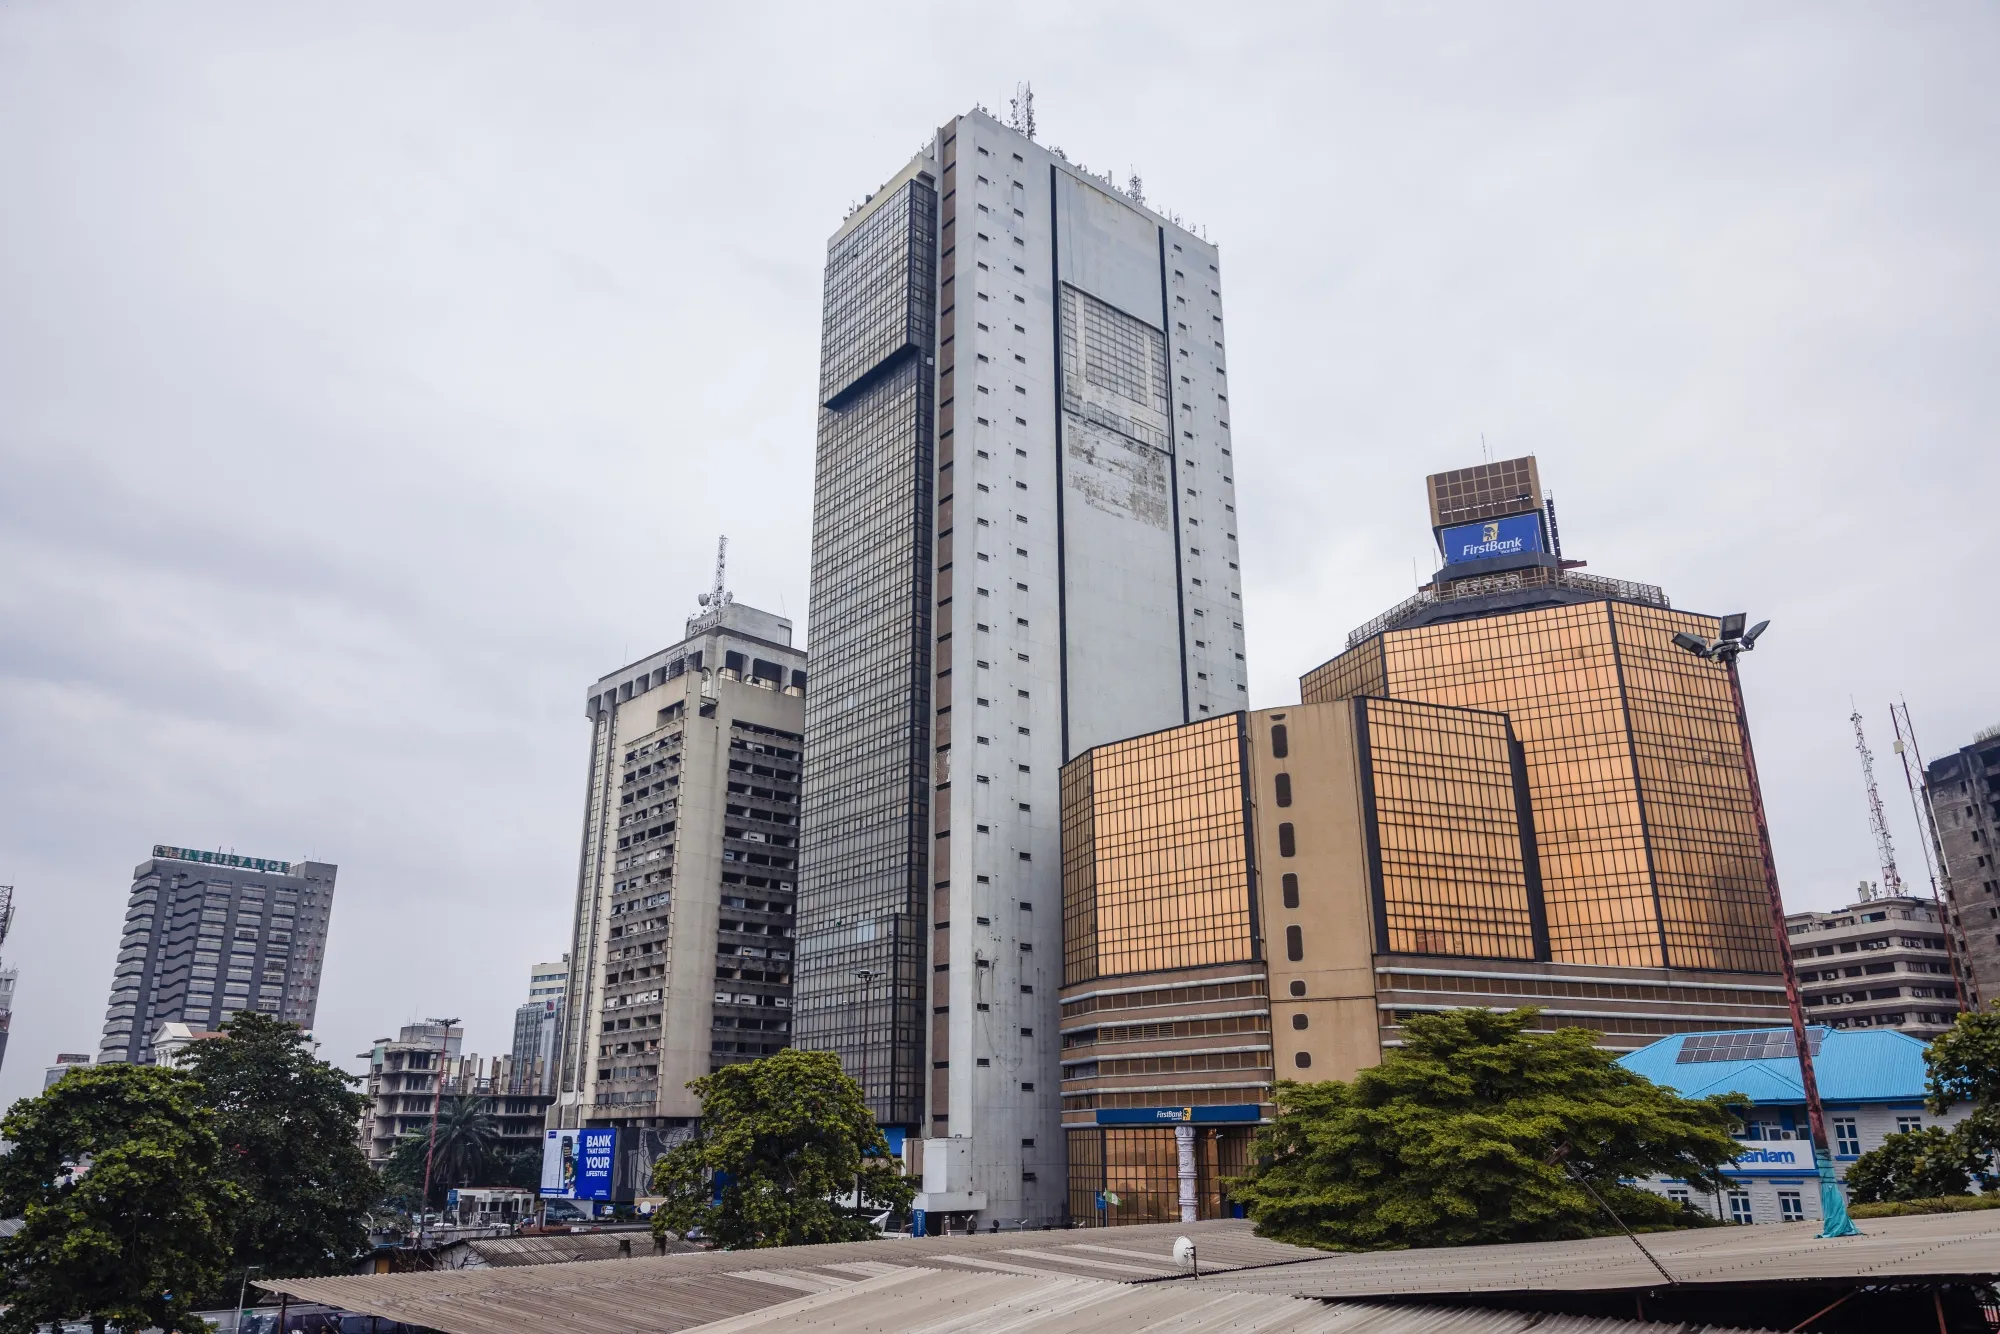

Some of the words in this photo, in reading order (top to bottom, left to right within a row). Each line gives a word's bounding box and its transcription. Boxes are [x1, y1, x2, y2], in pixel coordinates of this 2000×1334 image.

[1463, 537, 1522, 555] FirstBank
[691, 611, 722, 635] Conoil
[152, 844, 291, 874] REINSURANCE
[1156, 1110, 1183, 1118] FirstBank
[586, 1135, 611, 1147] BANK
[586, 1156, 610, 1169] YOUR
